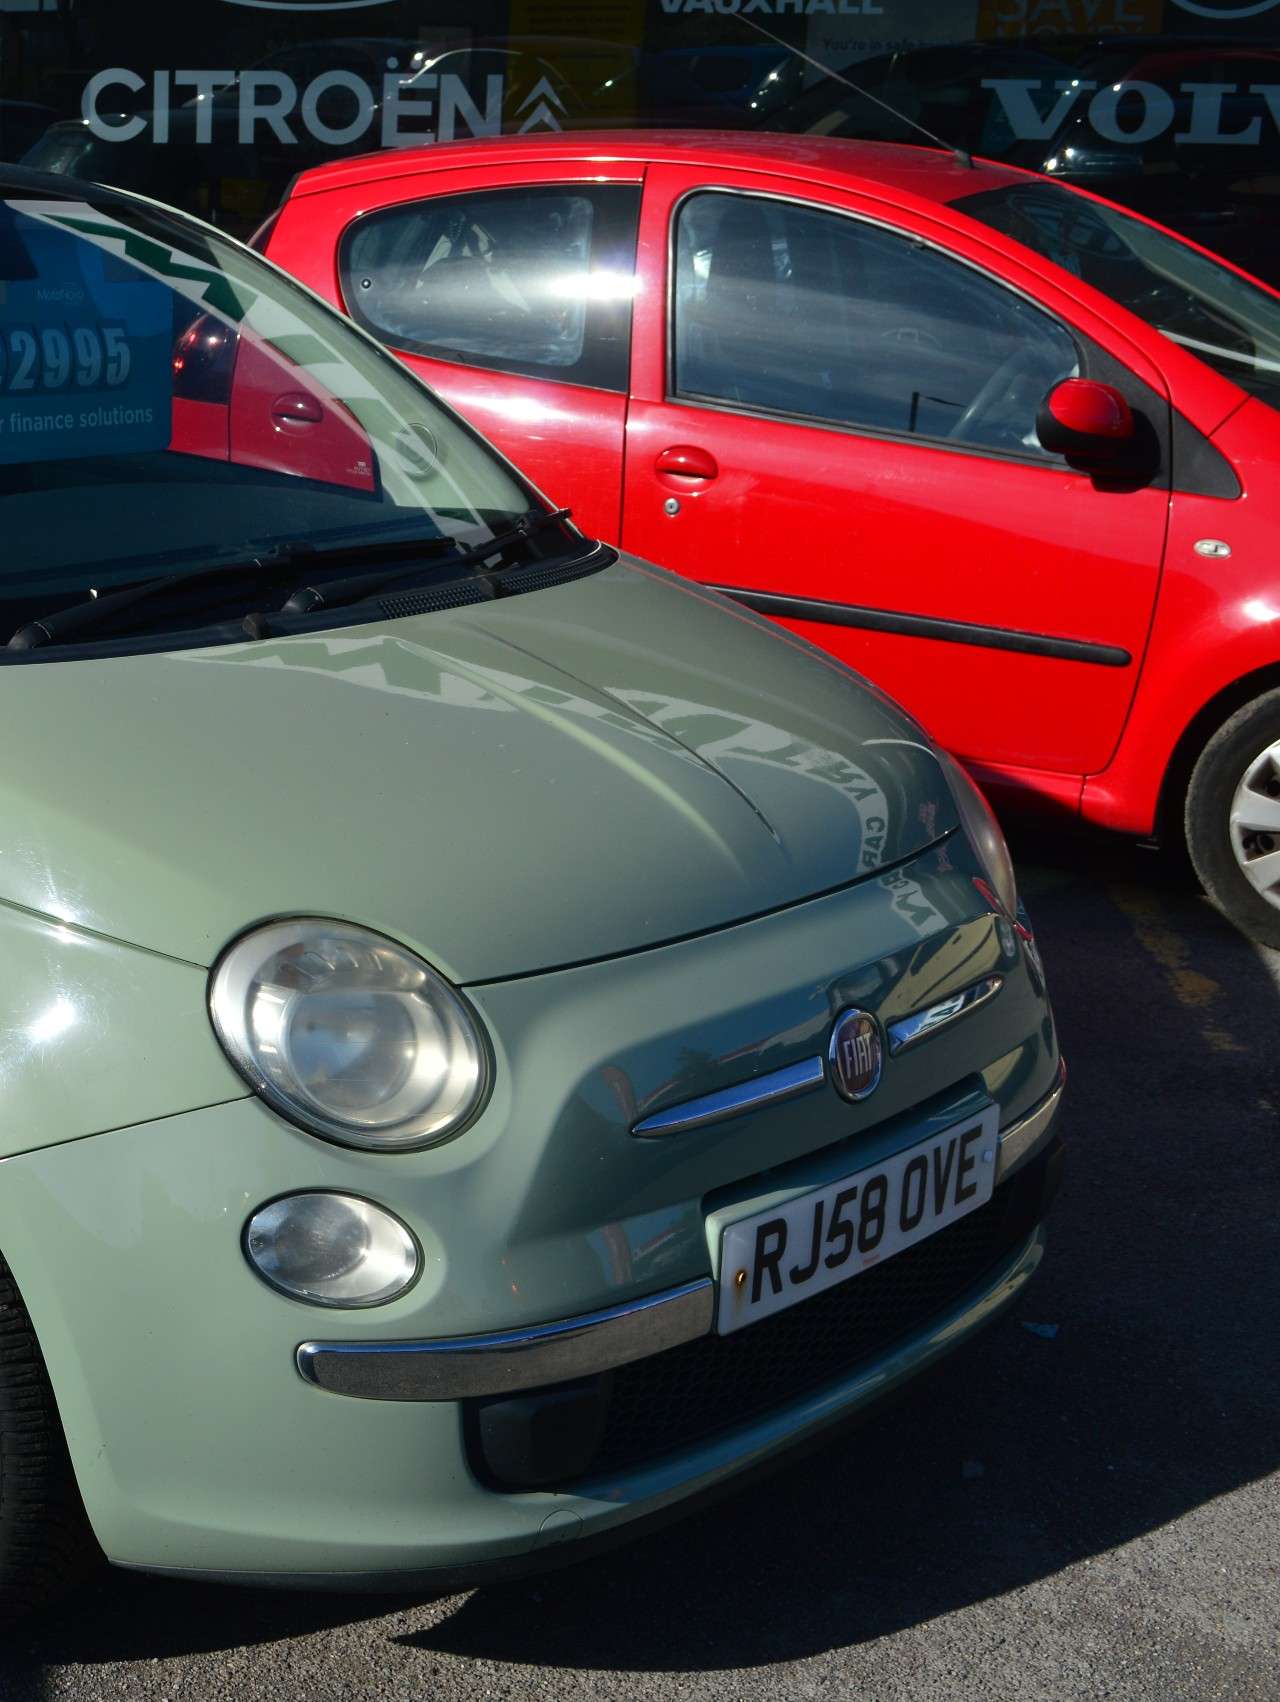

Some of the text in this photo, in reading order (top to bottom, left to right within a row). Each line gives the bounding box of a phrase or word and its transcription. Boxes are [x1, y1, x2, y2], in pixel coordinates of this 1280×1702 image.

[81, 56, 503, 147] CITROËN
[980, 78, 1280, 145] VOL
[10, 411, 74, 433] finance
[79, 405, 153, 428] solutions
[843, 1032, 872, 1080] FIAT
[751, 1124, 983, 1304] RJ58 OVE
